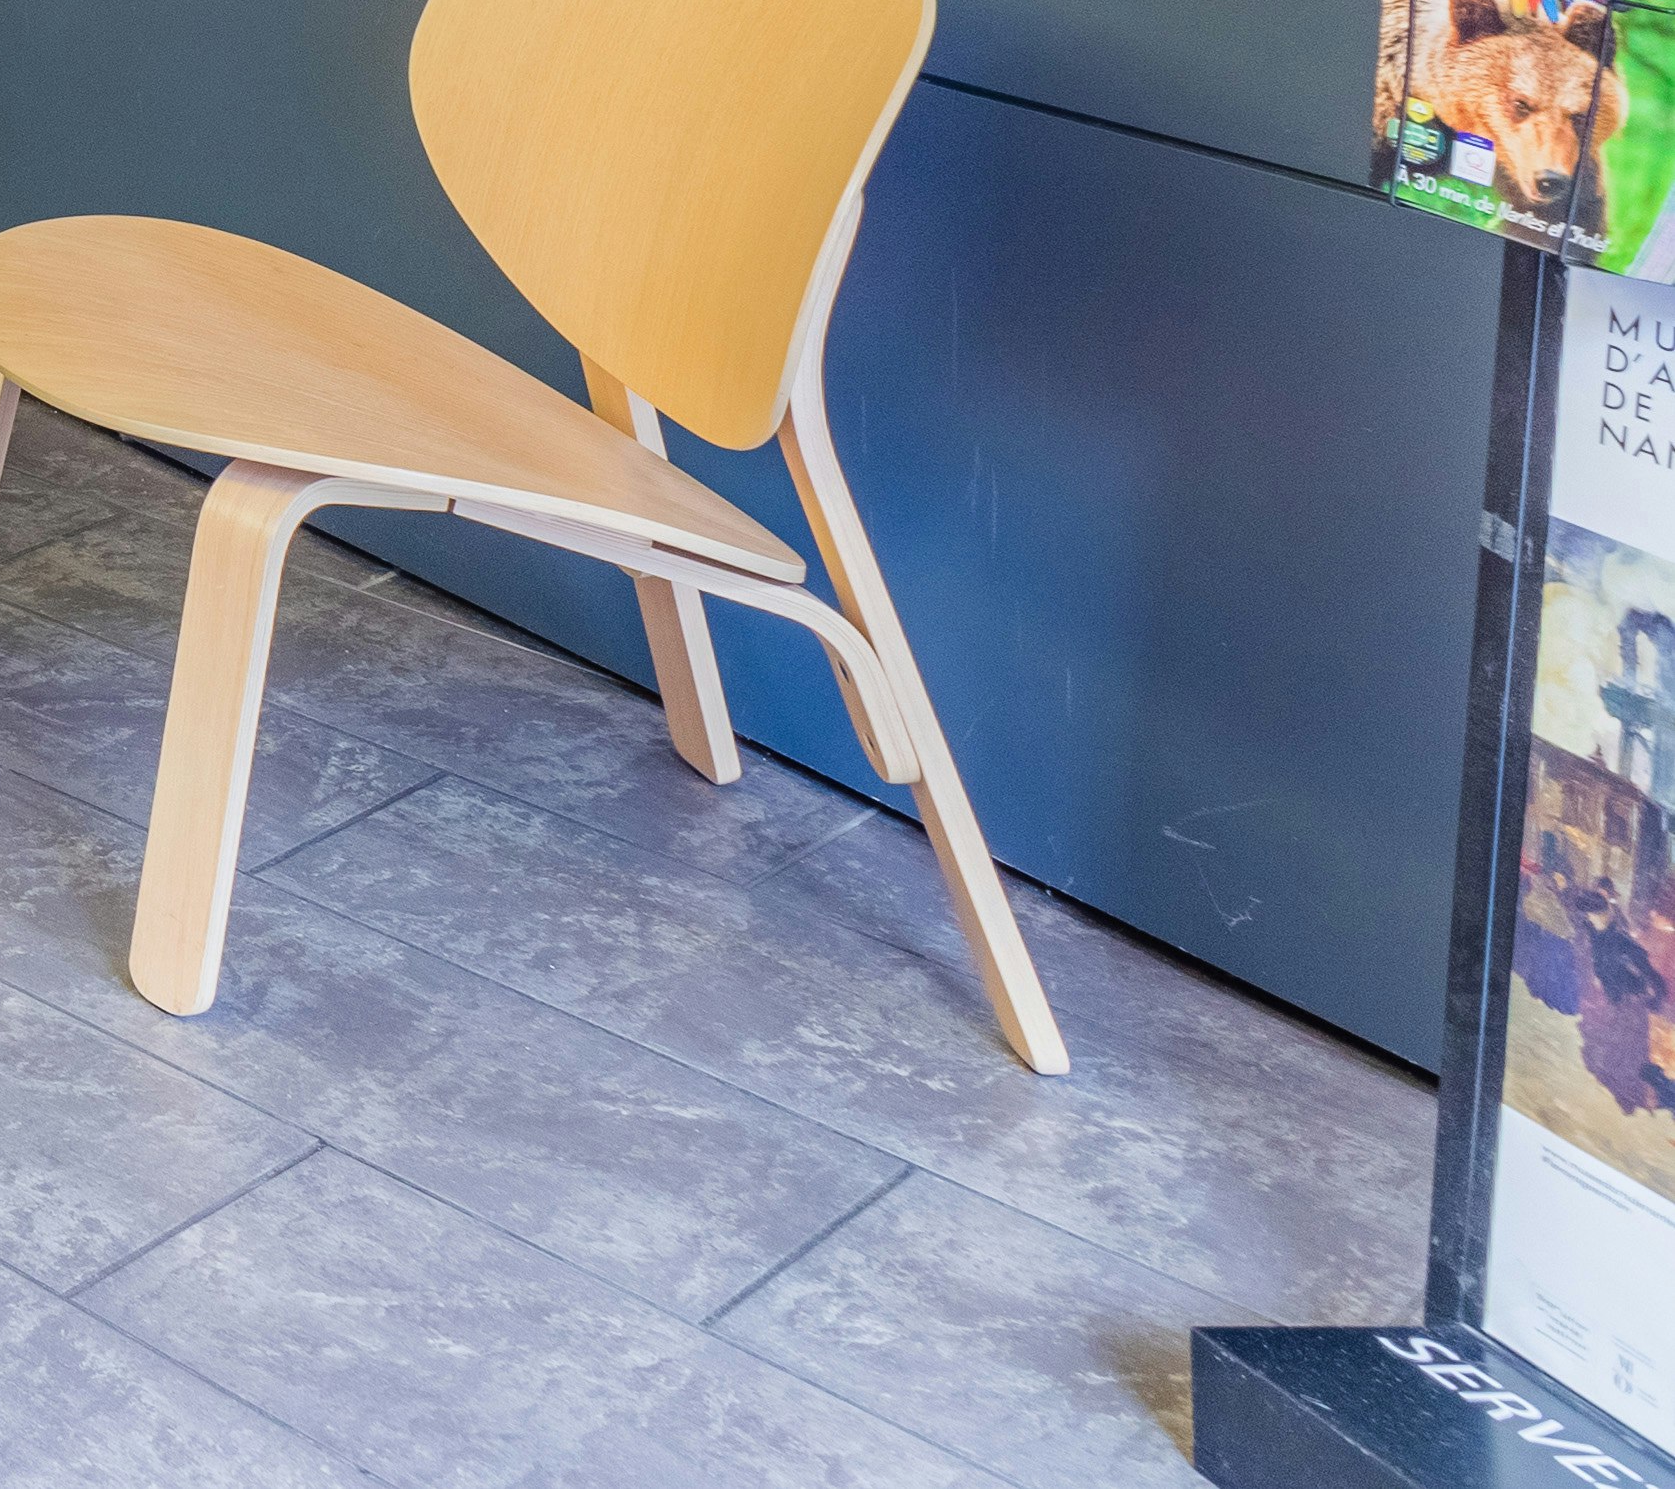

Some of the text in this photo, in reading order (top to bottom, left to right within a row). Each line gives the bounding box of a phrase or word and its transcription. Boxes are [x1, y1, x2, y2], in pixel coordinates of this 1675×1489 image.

[1412, 172, 1437, 194] 30
[1476, 196, 1495, 215] de
[1497, 201, 1547, 233] Nantes
[1602, 381, 1653, 423] DE
[1375, 1333, 1662, 1489] SERVE
